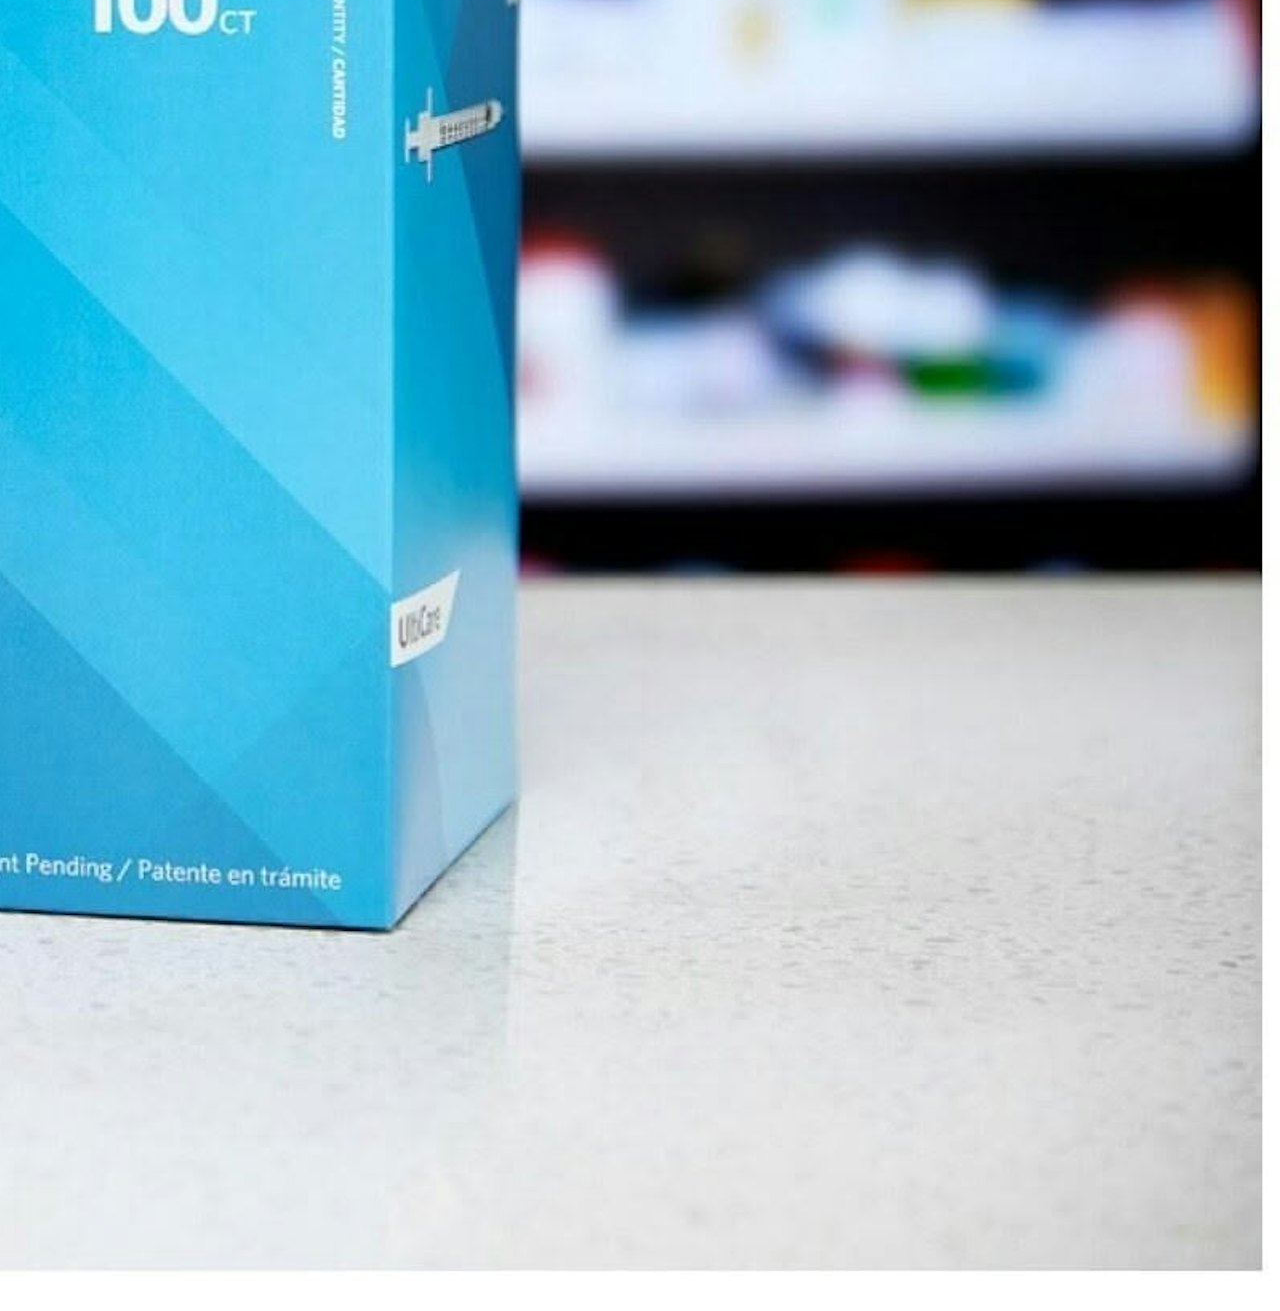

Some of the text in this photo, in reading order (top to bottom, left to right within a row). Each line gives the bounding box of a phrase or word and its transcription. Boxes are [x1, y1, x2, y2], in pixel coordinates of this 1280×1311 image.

[332, 57, 347, 139] CANTIDAD
[25, 852, 113, 883] Pending
[138, 858, 222, 885] Patente
[226, 868, 255, 886] en
[260, 866, 342, 891] trámite
